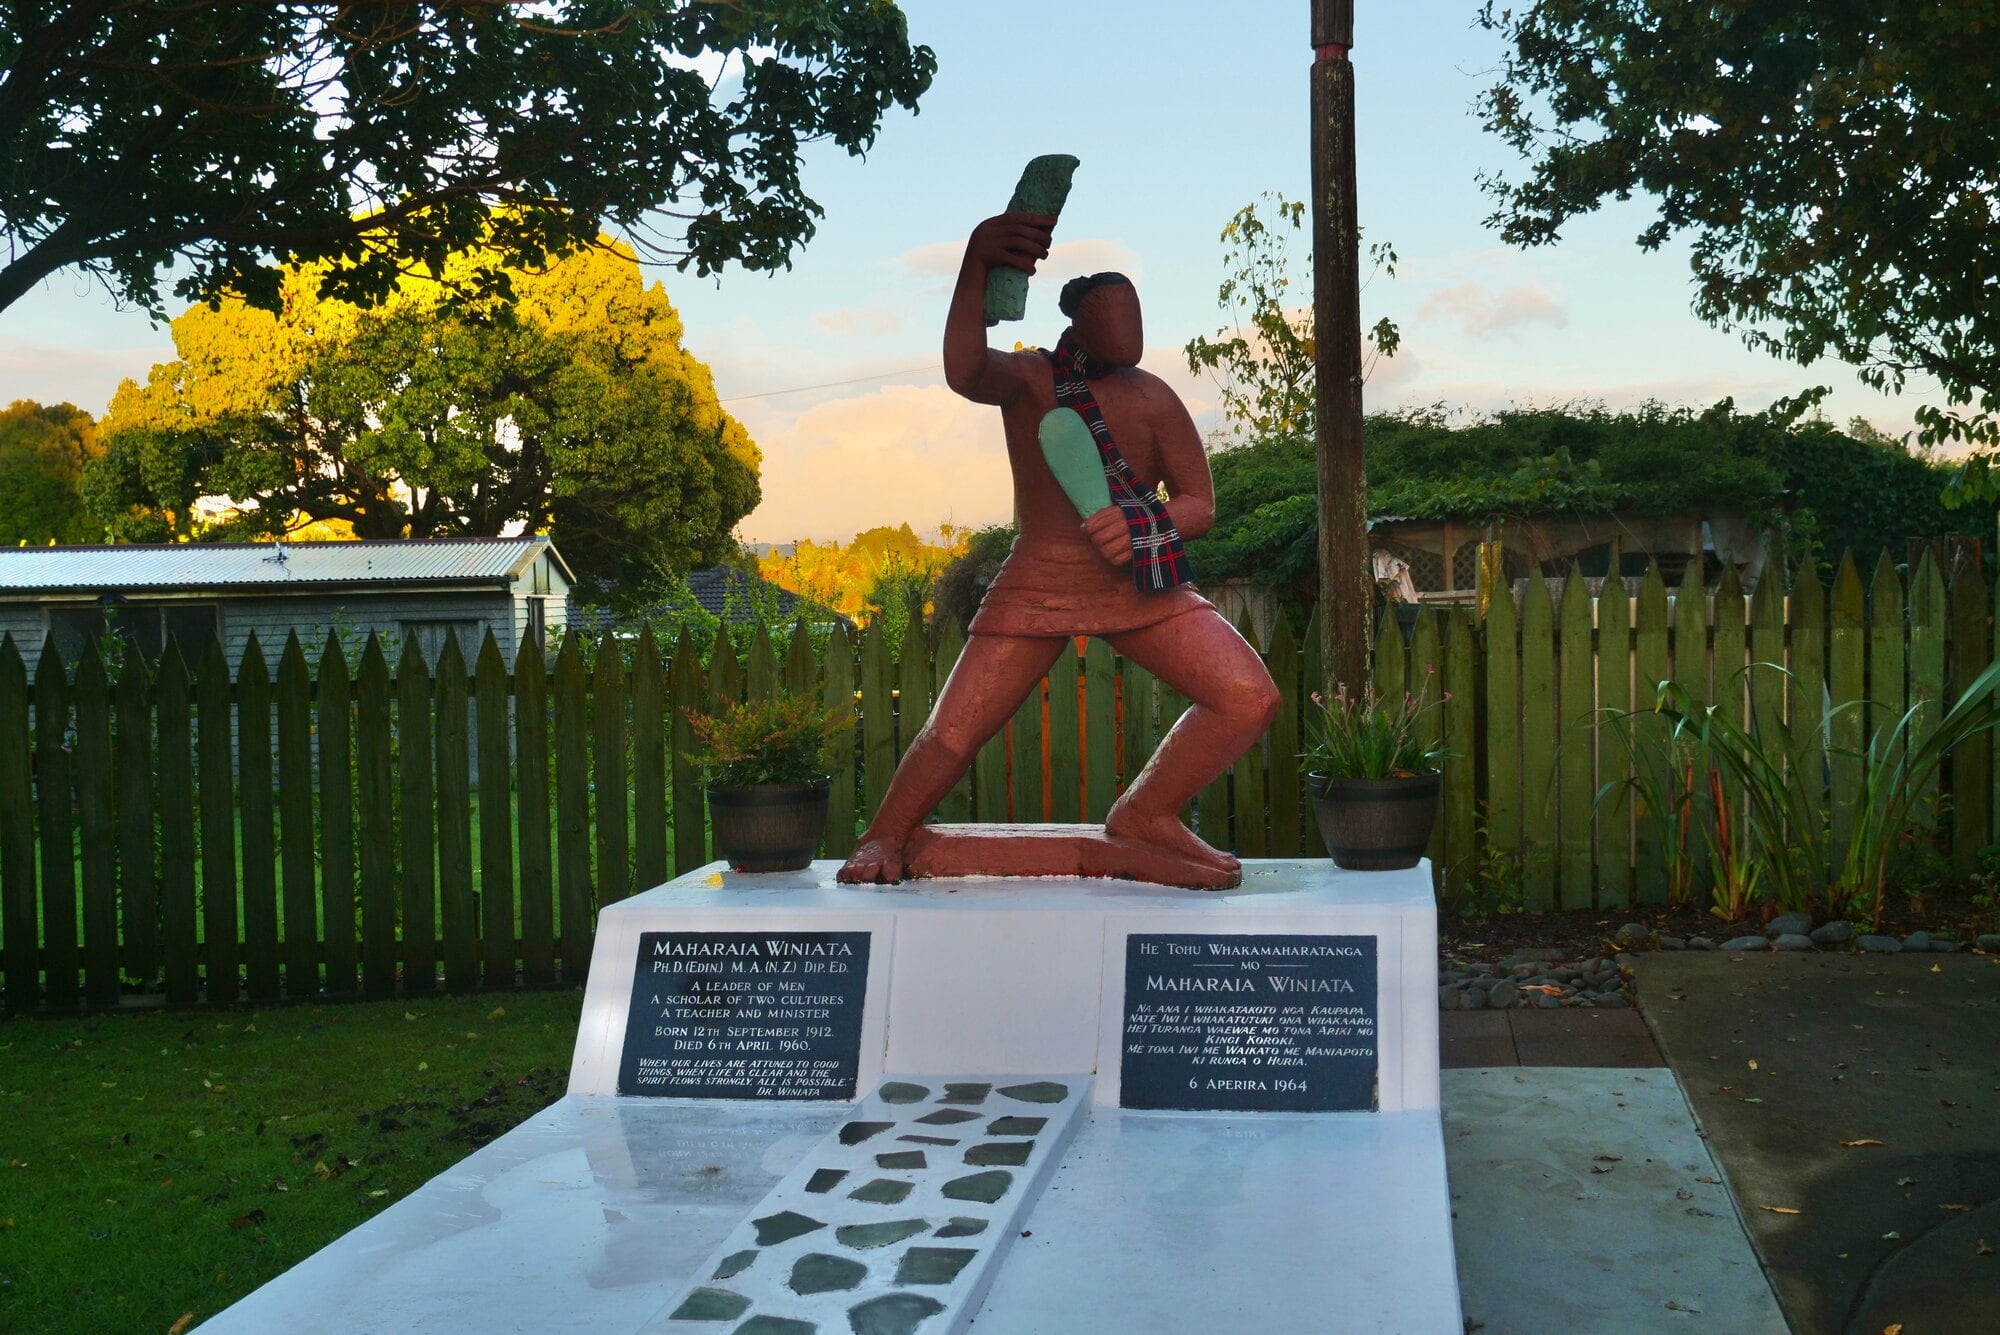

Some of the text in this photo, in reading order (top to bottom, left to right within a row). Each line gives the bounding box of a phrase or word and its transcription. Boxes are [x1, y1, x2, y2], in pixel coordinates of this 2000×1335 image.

[653, 940, 853, 956] MAHARAIA WINIATA
[1140, 943, 1363, 956] HE TOHU WHAKAMAHARATANGA
[1240, 961, 1260, 971] MO
[691, 981, 805, 991] A LEADER OF MEN
[1146, 975, 1355, 993] MAHARAIA WINIATA
[651, 995, 844, 1005] A SCHOLAR OF TWO CULTURES
[661, 1008, 830, 1019] A TEACHER AND MINISTER
[1137, 1004, 1151, 1014] NA
[1156, 1005, 1180, 1014] ANA
[1184, 1005, 1190, 1014] I
[1194, 1005, 1277, 1014] WHAKATAKOTO
[1282, 1006, 1304, 1015] NGA
[1162, 1014, 1180, 1023] IWI
[1183, 1015, 1188, 1023] I
[1192, 1015, 1274, 1024] WHAKATUTUKI
[1279, 1016, 1302, 1024] ONA
[654, 1026, 687, 1037] BORN
[727, 1027, 800, 1037] SEPTEMBER
[1126, 1024, 1373, 1036] HEI TURANGA WAEWAE MO TONA ARIKI MO
[1205, 1035, 1295, 1045] KINGI KOROKI.
[674, 1040, 703, 1050] DIED
[736, 1040, 773, 1051] APRIL
[779, 1041, 811, 1052] 1960.
[1127, 1044, 1373, 1056] ME TONA IWI ME WAIKATO ME MANIAPOTO
[671, 1060, 691, 1068] OUR
[694, 1060, 723, 1068] LIVES
[726, 1060, 746, 1068] ARE
[748, 1060, 793, 1068] ATTUNED
[796, 1060, 810, 1068] TO
[813, 1060, 839, 1069] GOOD
[1192, 1056, 1307, 1066] KI RUNGA O HURIA.
[677, 1069, 705, 1077] WHEN
[707, 1069, 732, 1077] LIFE
[735, 1069, 746, 1077] IS
[748, 1069, 783, 1077] CLEAR
[785, 1069, 807, 1077] AND
[811, 1069, 831, 1078] THE
[669, 1077, 701, 1085] FLOWS
[756, 1077, 778, 1086] ALL
[781, 1077, 791, 1086] IS
[1189, 1076, 1308, 1093] 6 APERIRA 1964
[756, 1086, 820, 1096] DR. WINIATA
